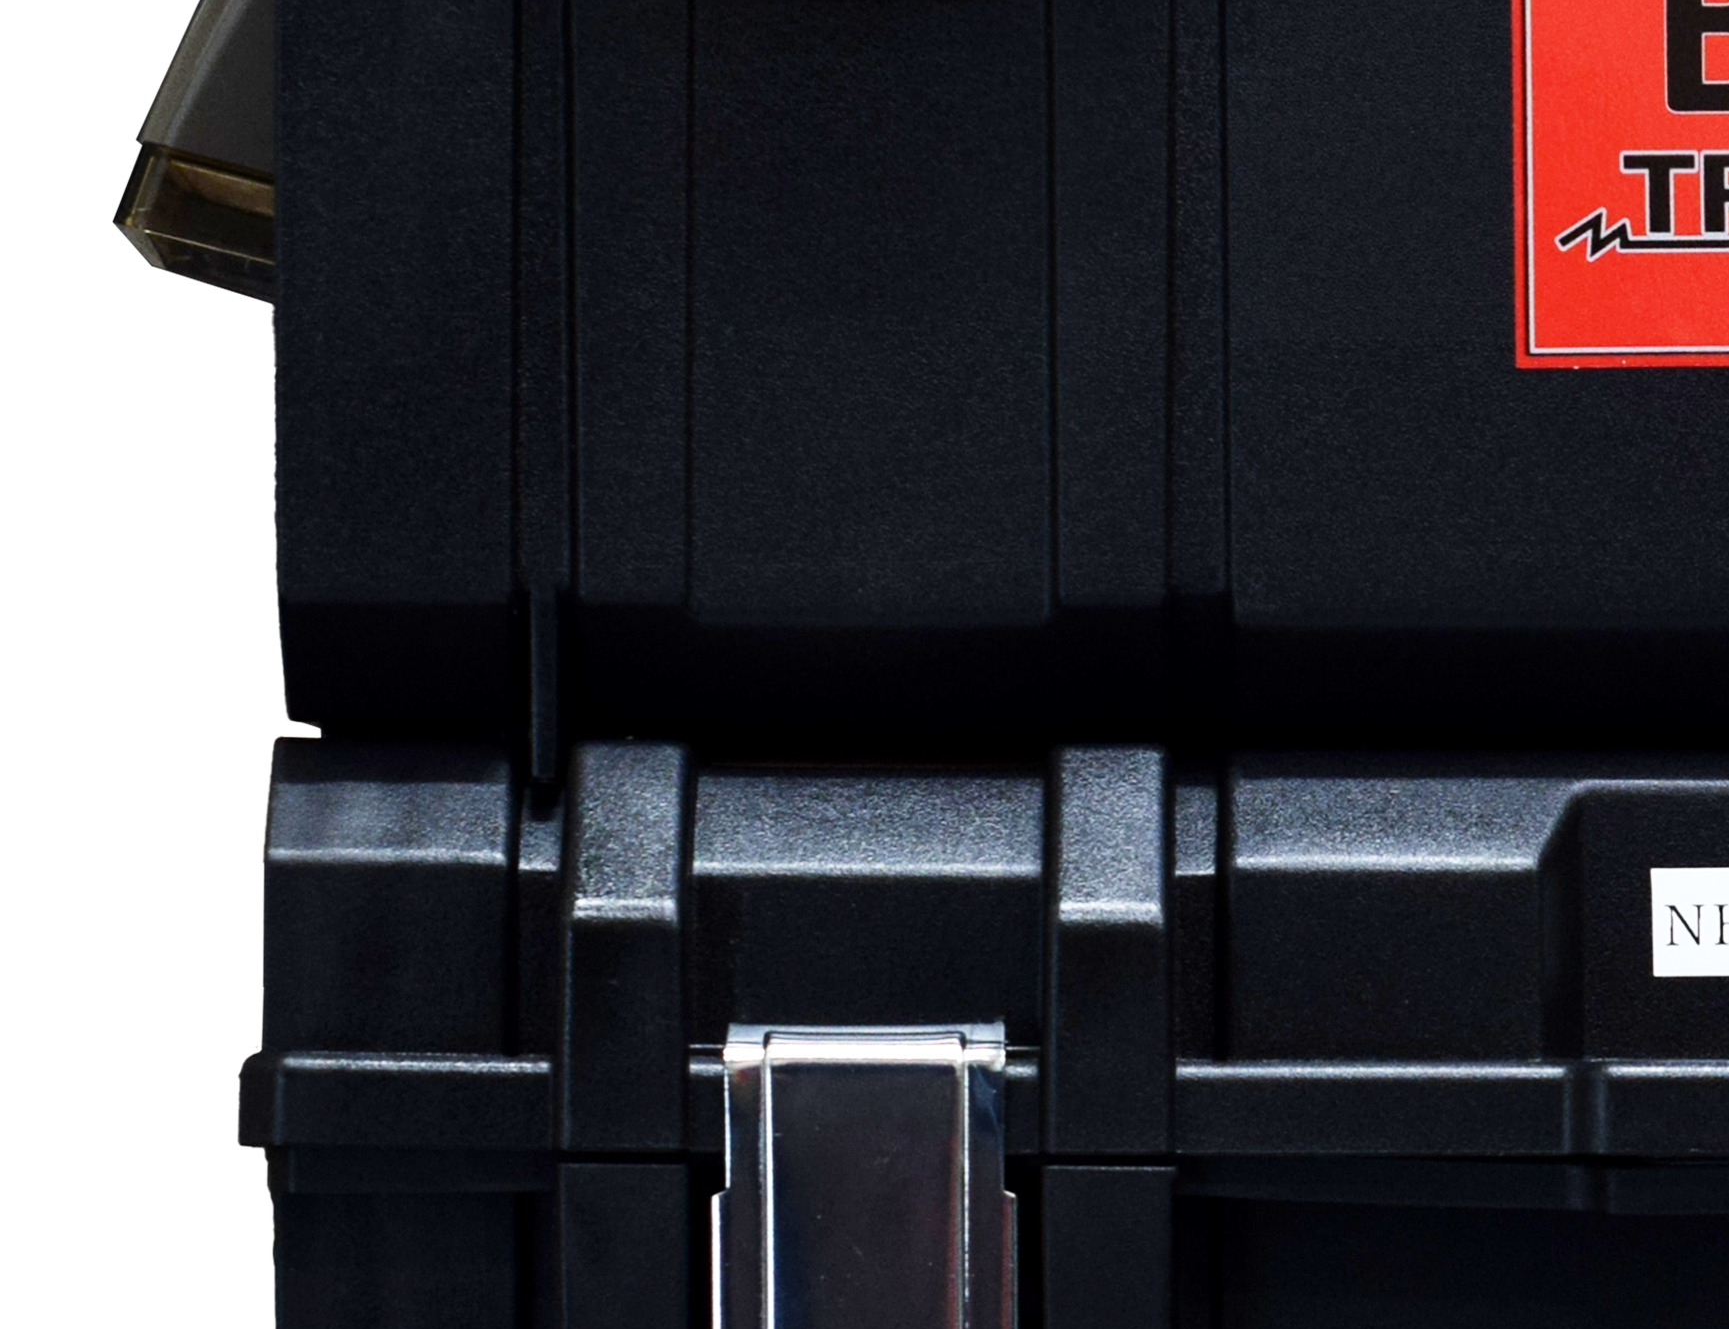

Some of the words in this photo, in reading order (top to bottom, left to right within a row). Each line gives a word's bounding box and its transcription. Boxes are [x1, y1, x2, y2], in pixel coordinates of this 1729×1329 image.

[160, 1120, 236, 1150] HANG
[160, 1160, 223, 1190] RING
[160, 1237, 233, 1266] WITH
